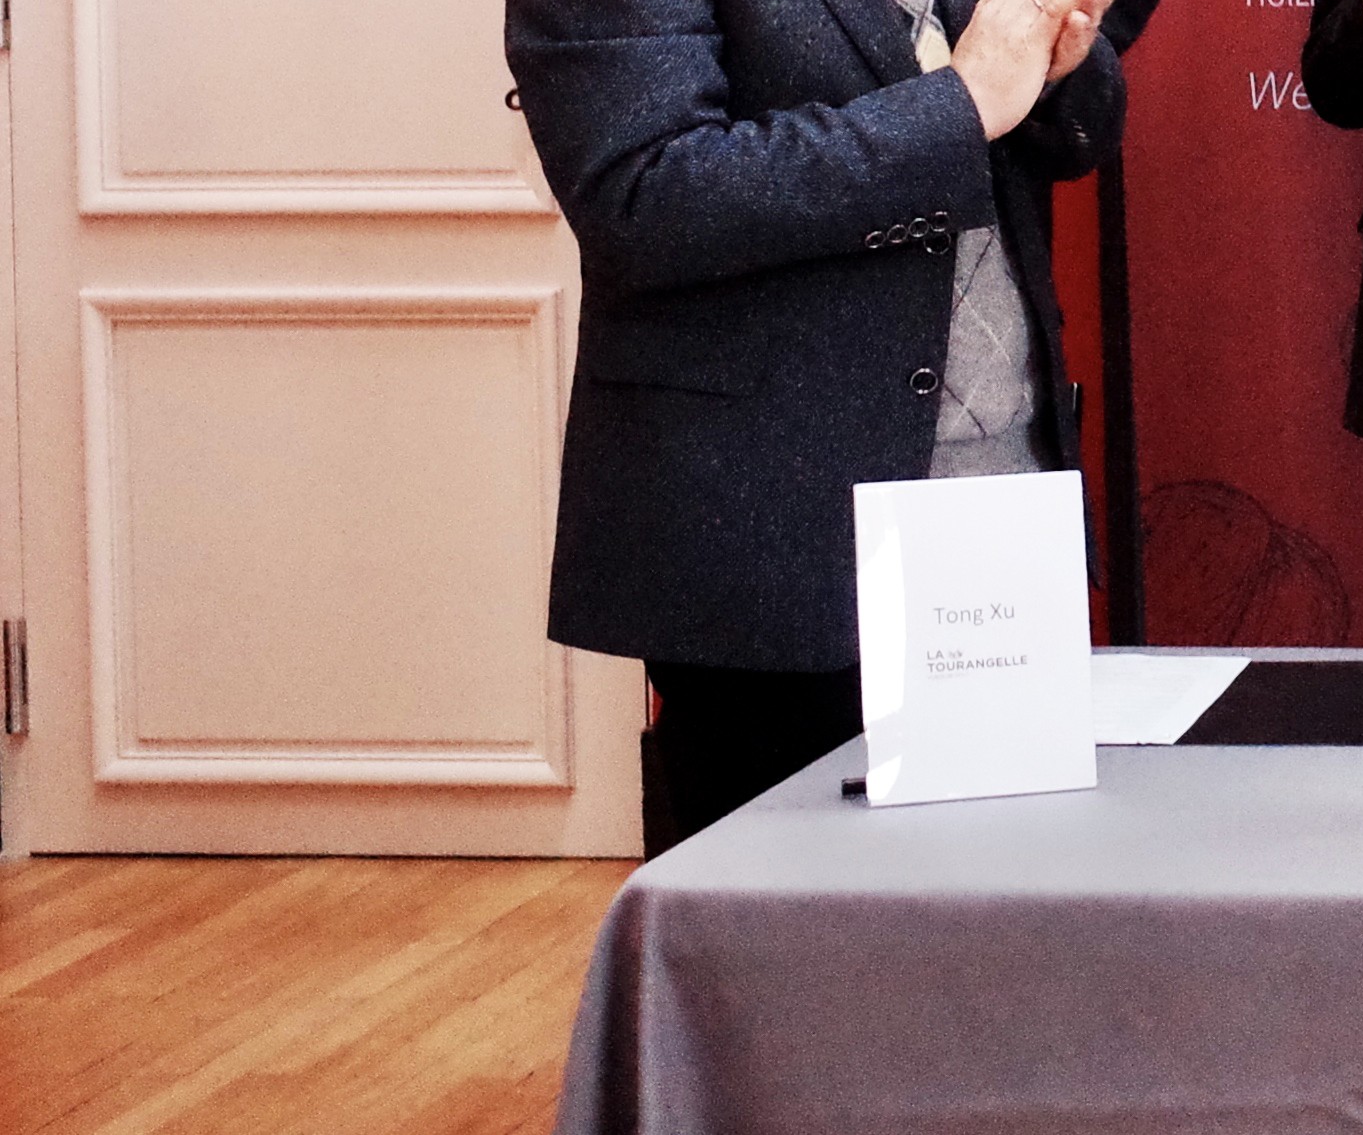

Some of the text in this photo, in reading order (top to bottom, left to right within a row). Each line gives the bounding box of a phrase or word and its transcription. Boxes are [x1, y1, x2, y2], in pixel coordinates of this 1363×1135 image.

[932, 603, 1015, 626] Tong Xu
[926, 650, 944, 661] LA
[927, 655, 1028, 672] TOURANGELLE
